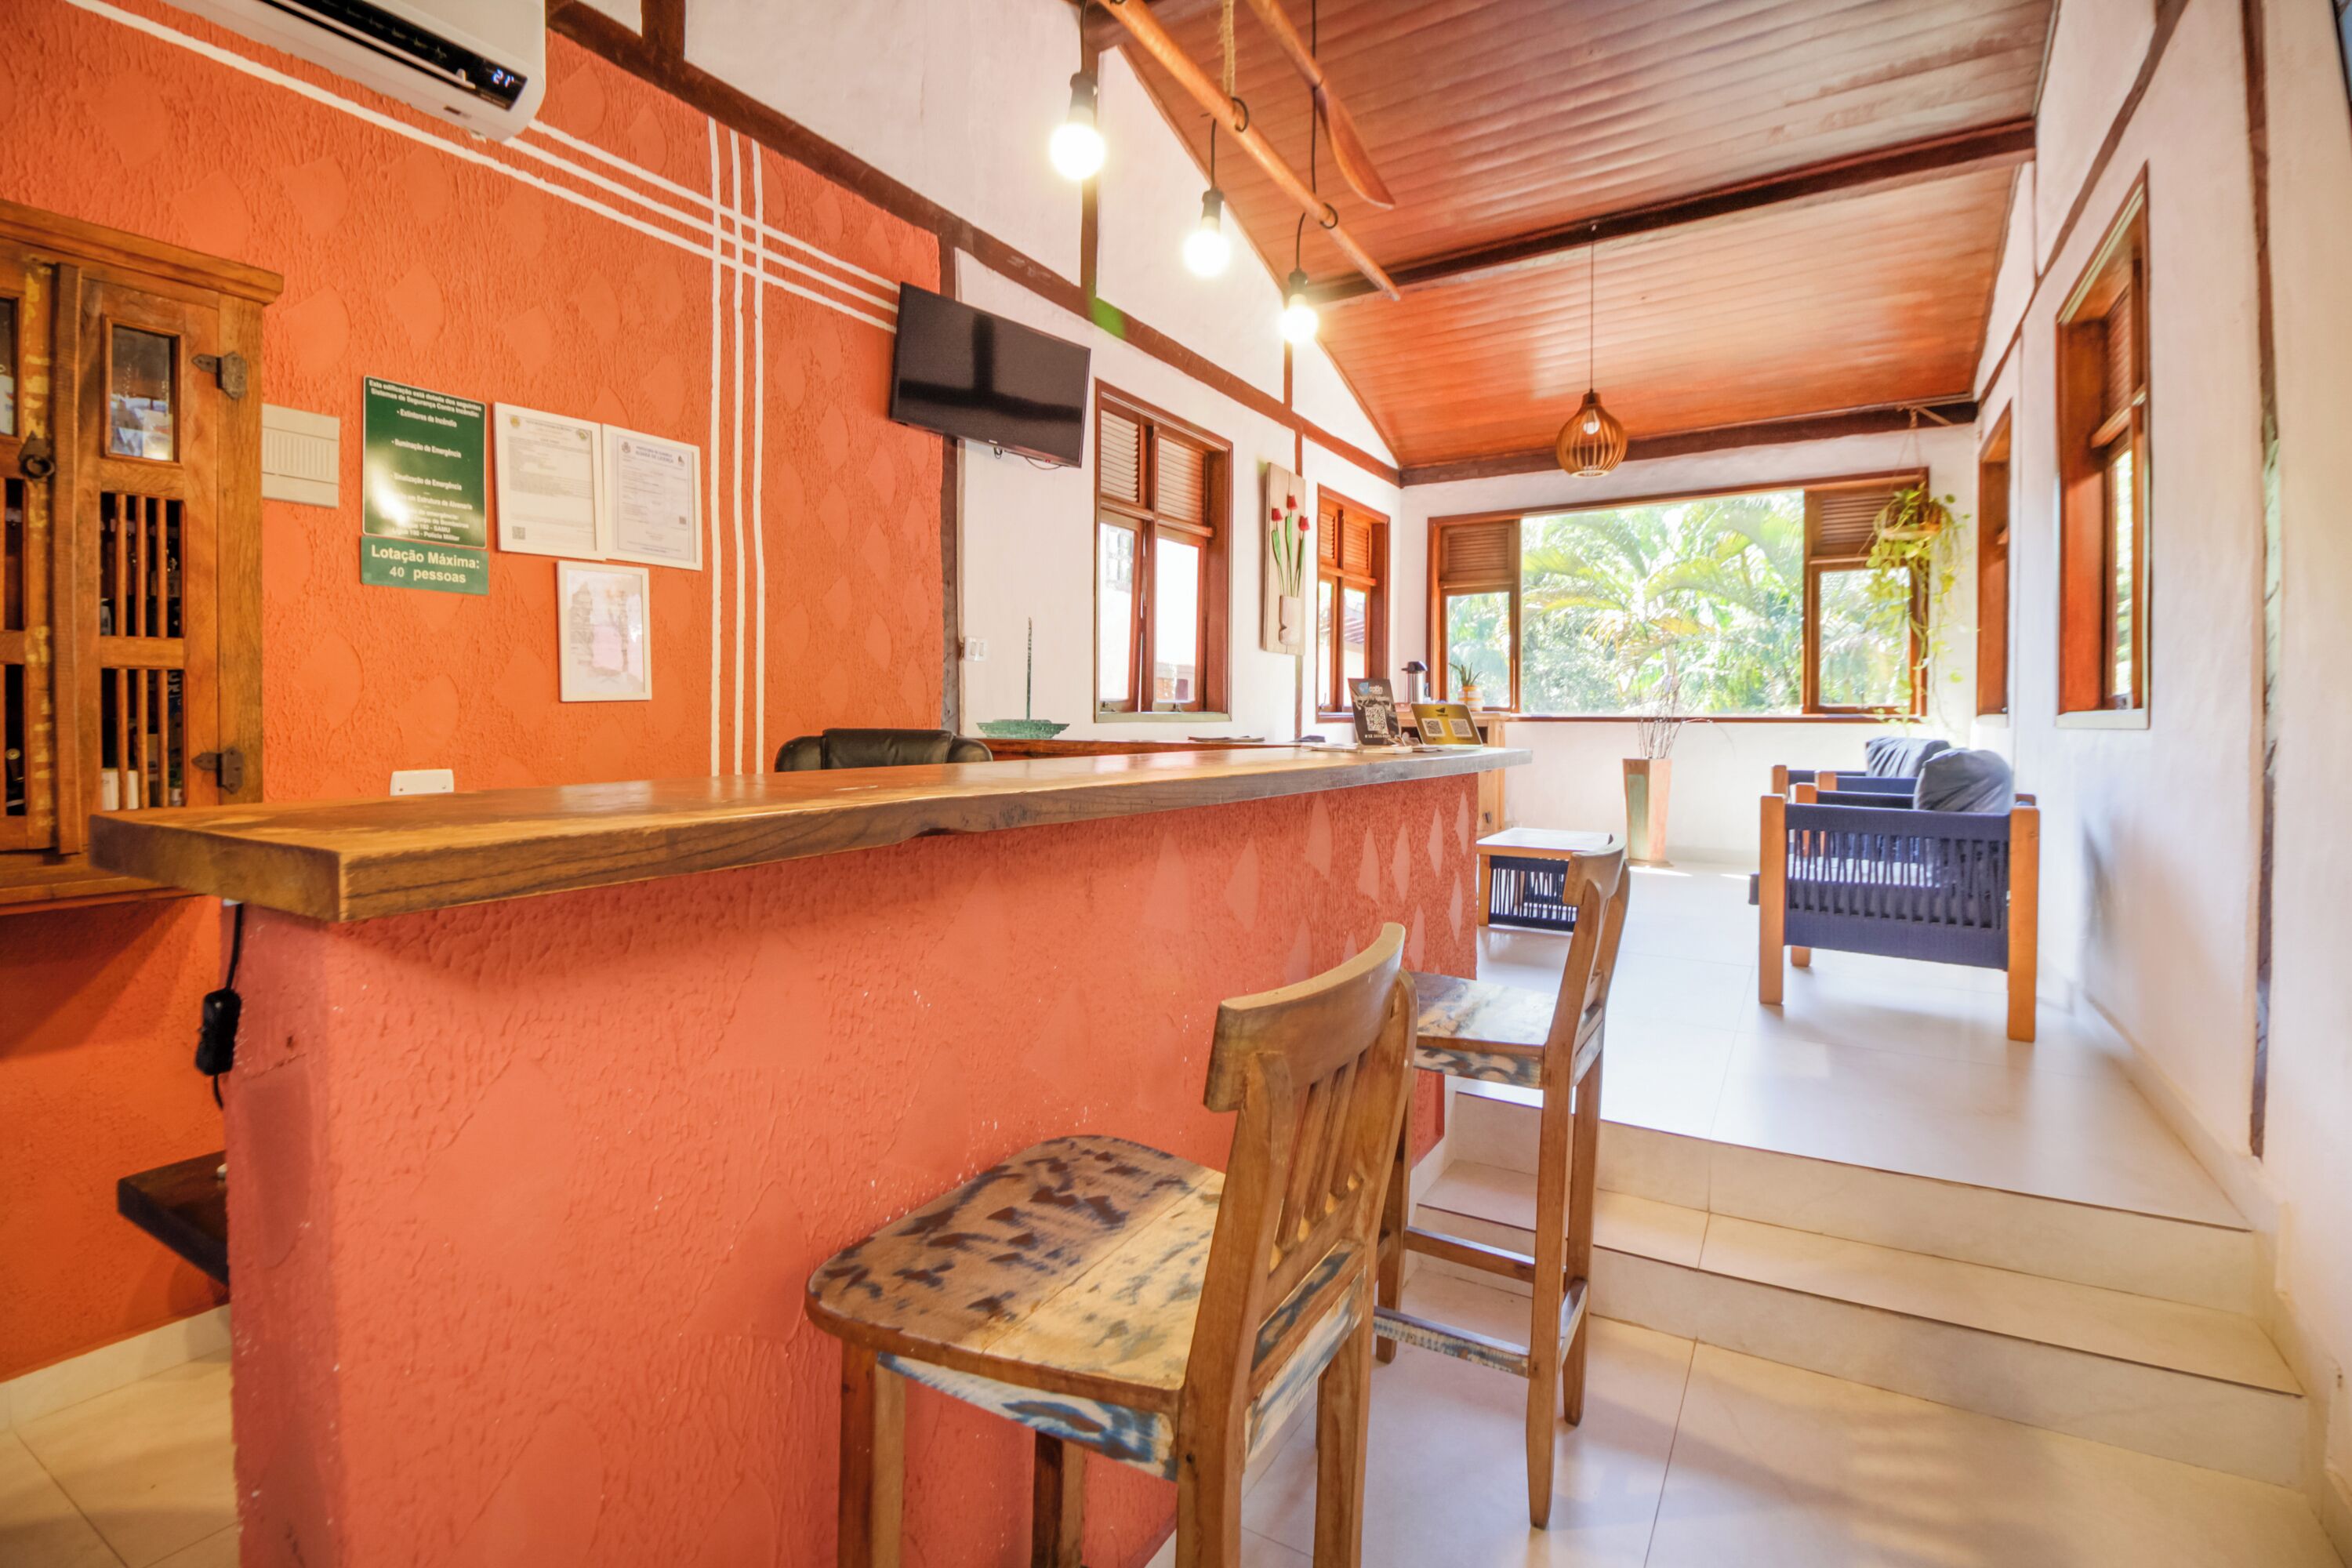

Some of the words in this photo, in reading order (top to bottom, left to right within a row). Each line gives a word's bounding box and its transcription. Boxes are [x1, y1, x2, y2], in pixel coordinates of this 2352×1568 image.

[371, 387, 397, 400] Sistemas
[406, 395, 436, 408] Segurança
[400, 408, 427, 422] Extintores
[435, 416, 457, 428] Incêndio
[394, 438, 423, 452] Iluminação
[432, 445, 462, 458] Emergência
[432, 479, 462, 491] Emergência
[372, 544, 424, 564] Lotação
[428, 551, 480, 569] Máxima:
[389, 566, 405, 578] 40
[413, 569, 466, 583] pessoas
